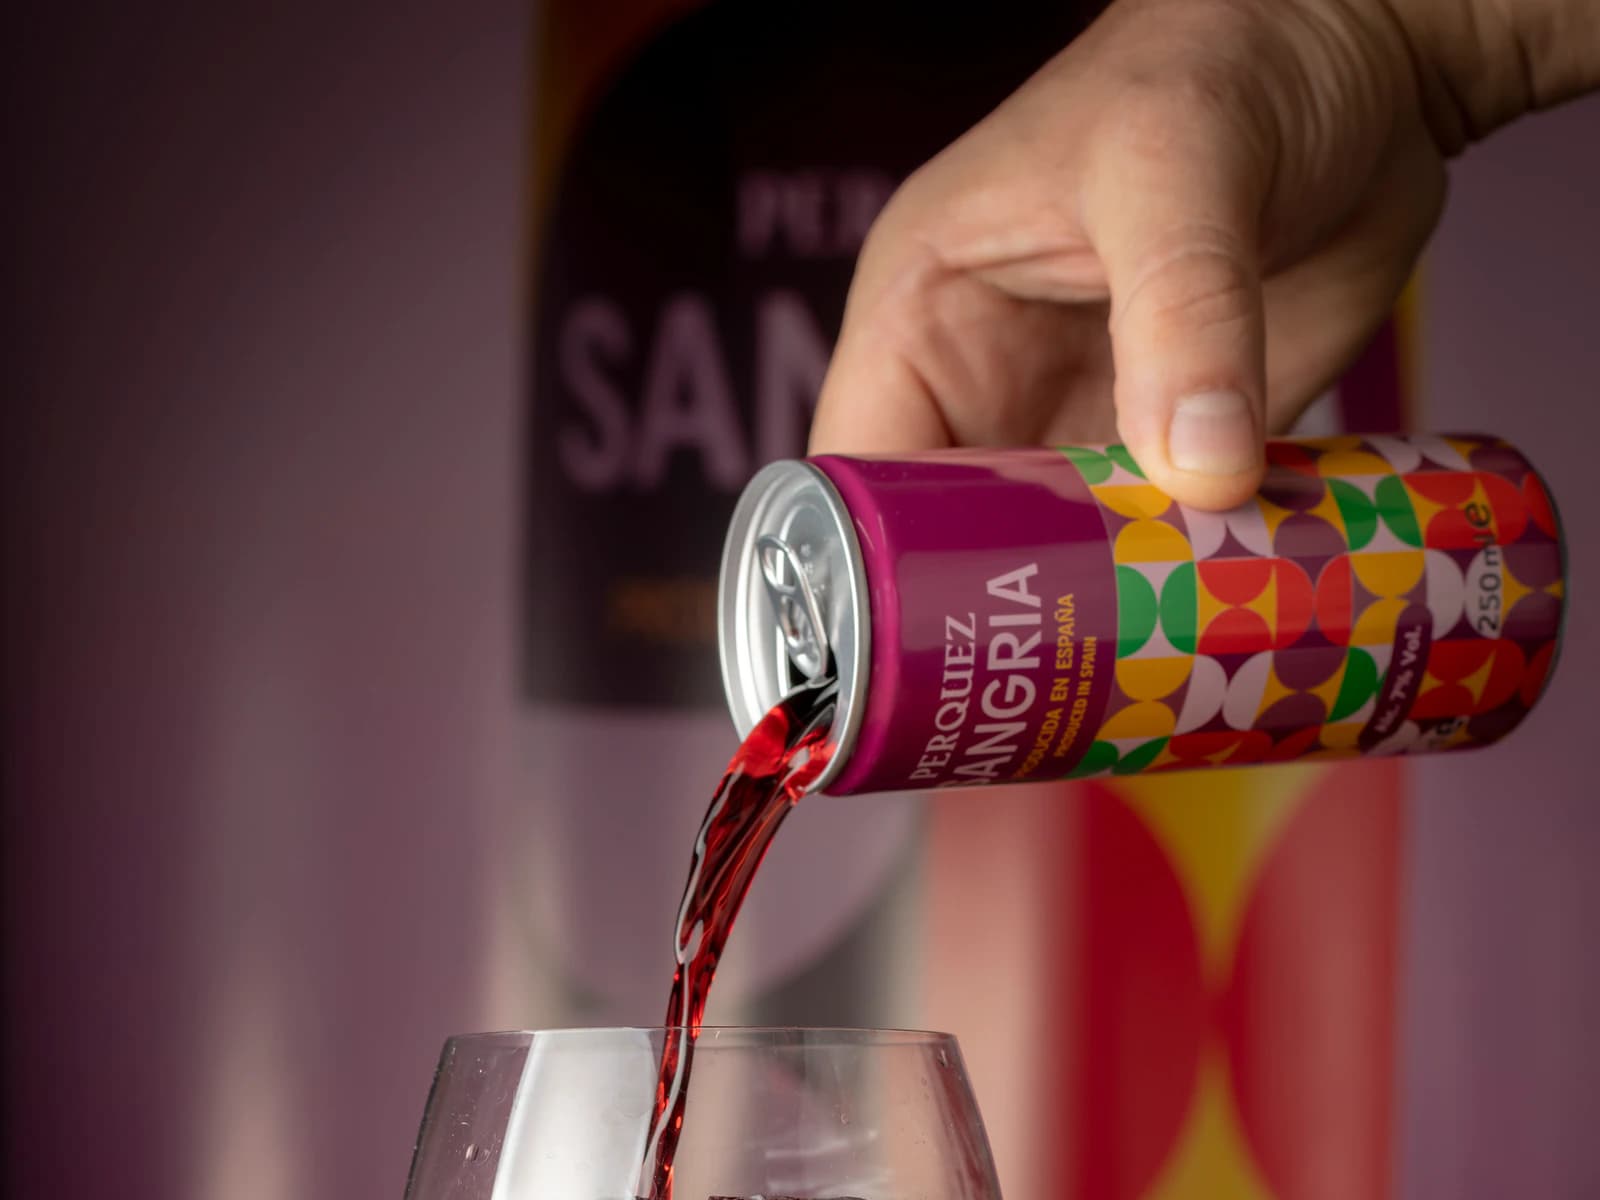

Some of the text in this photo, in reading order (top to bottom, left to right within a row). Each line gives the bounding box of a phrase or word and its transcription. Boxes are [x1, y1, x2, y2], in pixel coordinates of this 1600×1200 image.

[1054, 593, 1075, 670] ESPAÑA
[1477, 573, 1501, 632] 250
[1399, 624, 1423, 668] Vol.
[909, 612, 976, 780] PERQUEZ
[1050, 677, 1071, 702] EN
[1053, 636, 1097, 758] PRODUCED IN SPAIN
